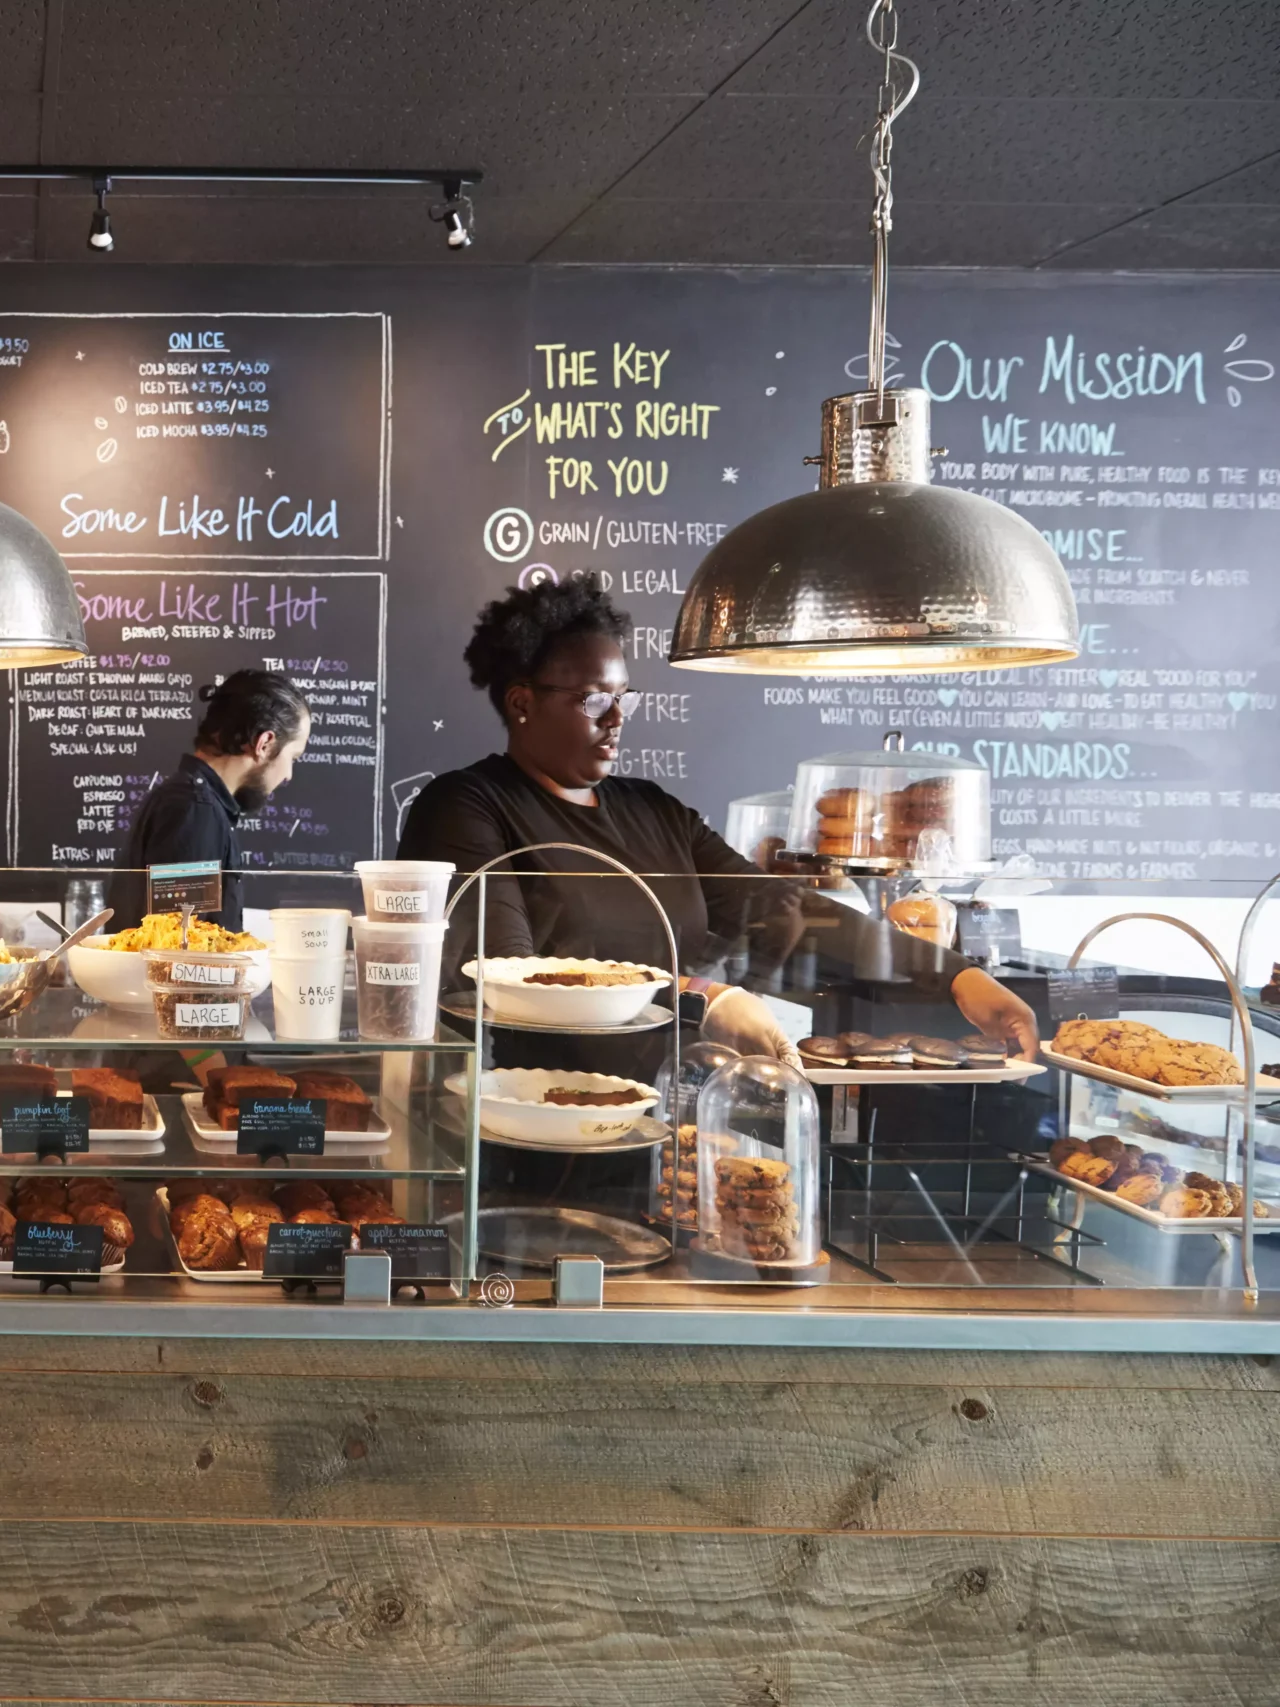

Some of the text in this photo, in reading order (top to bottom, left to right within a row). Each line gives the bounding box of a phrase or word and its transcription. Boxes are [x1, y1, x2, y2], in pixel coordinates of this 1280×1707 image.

[169, 332, 225, 349] ON ICE
[139, 364, 165, 375] COLD
[167, 364, 197, 375] BREW
[536, 342, 670, 390] THE KEY
[921, 334, 1206, 404] Our Mission
[140, 382, 165, 394] ICED
[167, 382, 188, 393] TEA
[136, 403, 158, 415] ICED
[162, 403, 193, 414] LATTE
[498, 401, 721, 445] TO WHAT'S RIGHT
[137, 426, 158, 438] ICED
[163, 425, 197, 437] MOCHA
[982, 415, 1027, 453] WE
[547, 456, 669, 498] FOR YOU
[941, 463, 976, 480] YOUR
[981, 463, 1018, 480] BODY
[1159, 467, 1190, 483] FOOD
[1217, 468, 1248, 484] THE
[61, 494, 338, 541] Some Like It Cold
[495, 517, 520, 552] G
[623, 569, 685, 594] LEGAL
[159, 581, 220, 622] Like
[232, 581, 260, 626] It
[266, 586, 327, 631] Hot
[122, 626, 275, 641] BREWED, STEEPED & SIPPED
[262, 658, 285, 671] TEA
[24, 673, 53, 685] LIGHT
[90, 690, 118, 701] COSTA
[120, 690, 146, 701] RICA
[342, 696, 367, 706] MINT
[764, 689, 938, 705] FOODS MAKE YOU FEEL GOOD
[28, 706, 55, 722] DARK
[92, 706, 121, 718] HEART
[126, 707, 138, 718] OF
[142, 707, 192, 719] DARKNESS
[820, 708, 883, 726] WHAT YOU
[86, 724, 145, 737] GUATEMALA
[94, 743, 137, 755] ASK US!
[74, 776, 122, 788] CAPPUCINO
[83, 805, 115, 816] LATTE
[77, 819, 115, 834] RED EYE
[96, 848, 116, 862] NUT
[377, 895, 421, 911] LARGE
[175, 964, 234, 983] SMALL
[367, 965, 418, 980] XTRA-LARGE
[299, 985, 336, 996] LARGE
[300, 996, 334, 1005] SOUP
[180, 1008, 230, 1024] LARGE
[14, 1102, 77, 1122] pumpkin loaf
[254, 1101, 312, 1114] banana bread
[28, 1226, 81, 1251] blueberry
[368, 1226, 447, 1244] apple cinnamon
